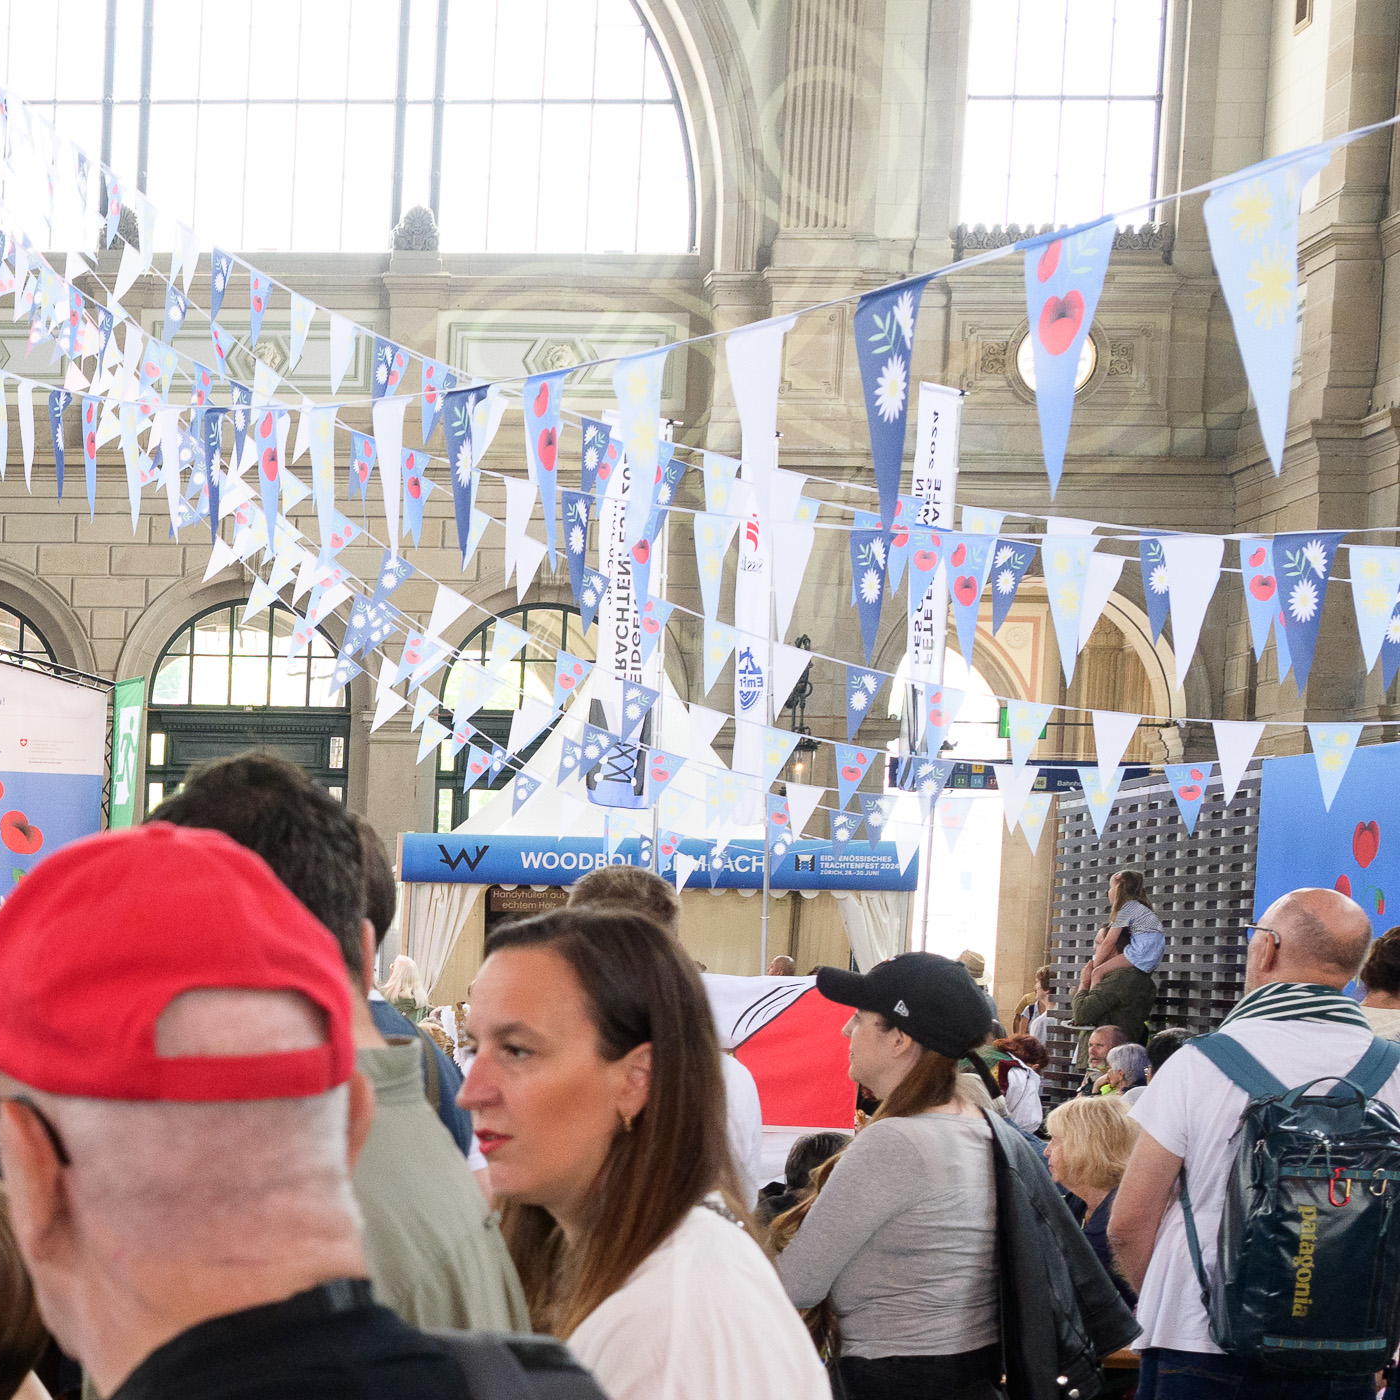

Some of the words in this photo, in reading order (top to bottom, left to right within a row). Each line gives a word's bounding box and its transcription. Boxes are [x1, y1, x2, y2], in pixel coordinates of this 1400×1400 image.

[493, 890, 548, 900] Handyhüllen
[502, 901, 537, 909] echtem
[1291, 1204, 1318, 1317] patagonia
